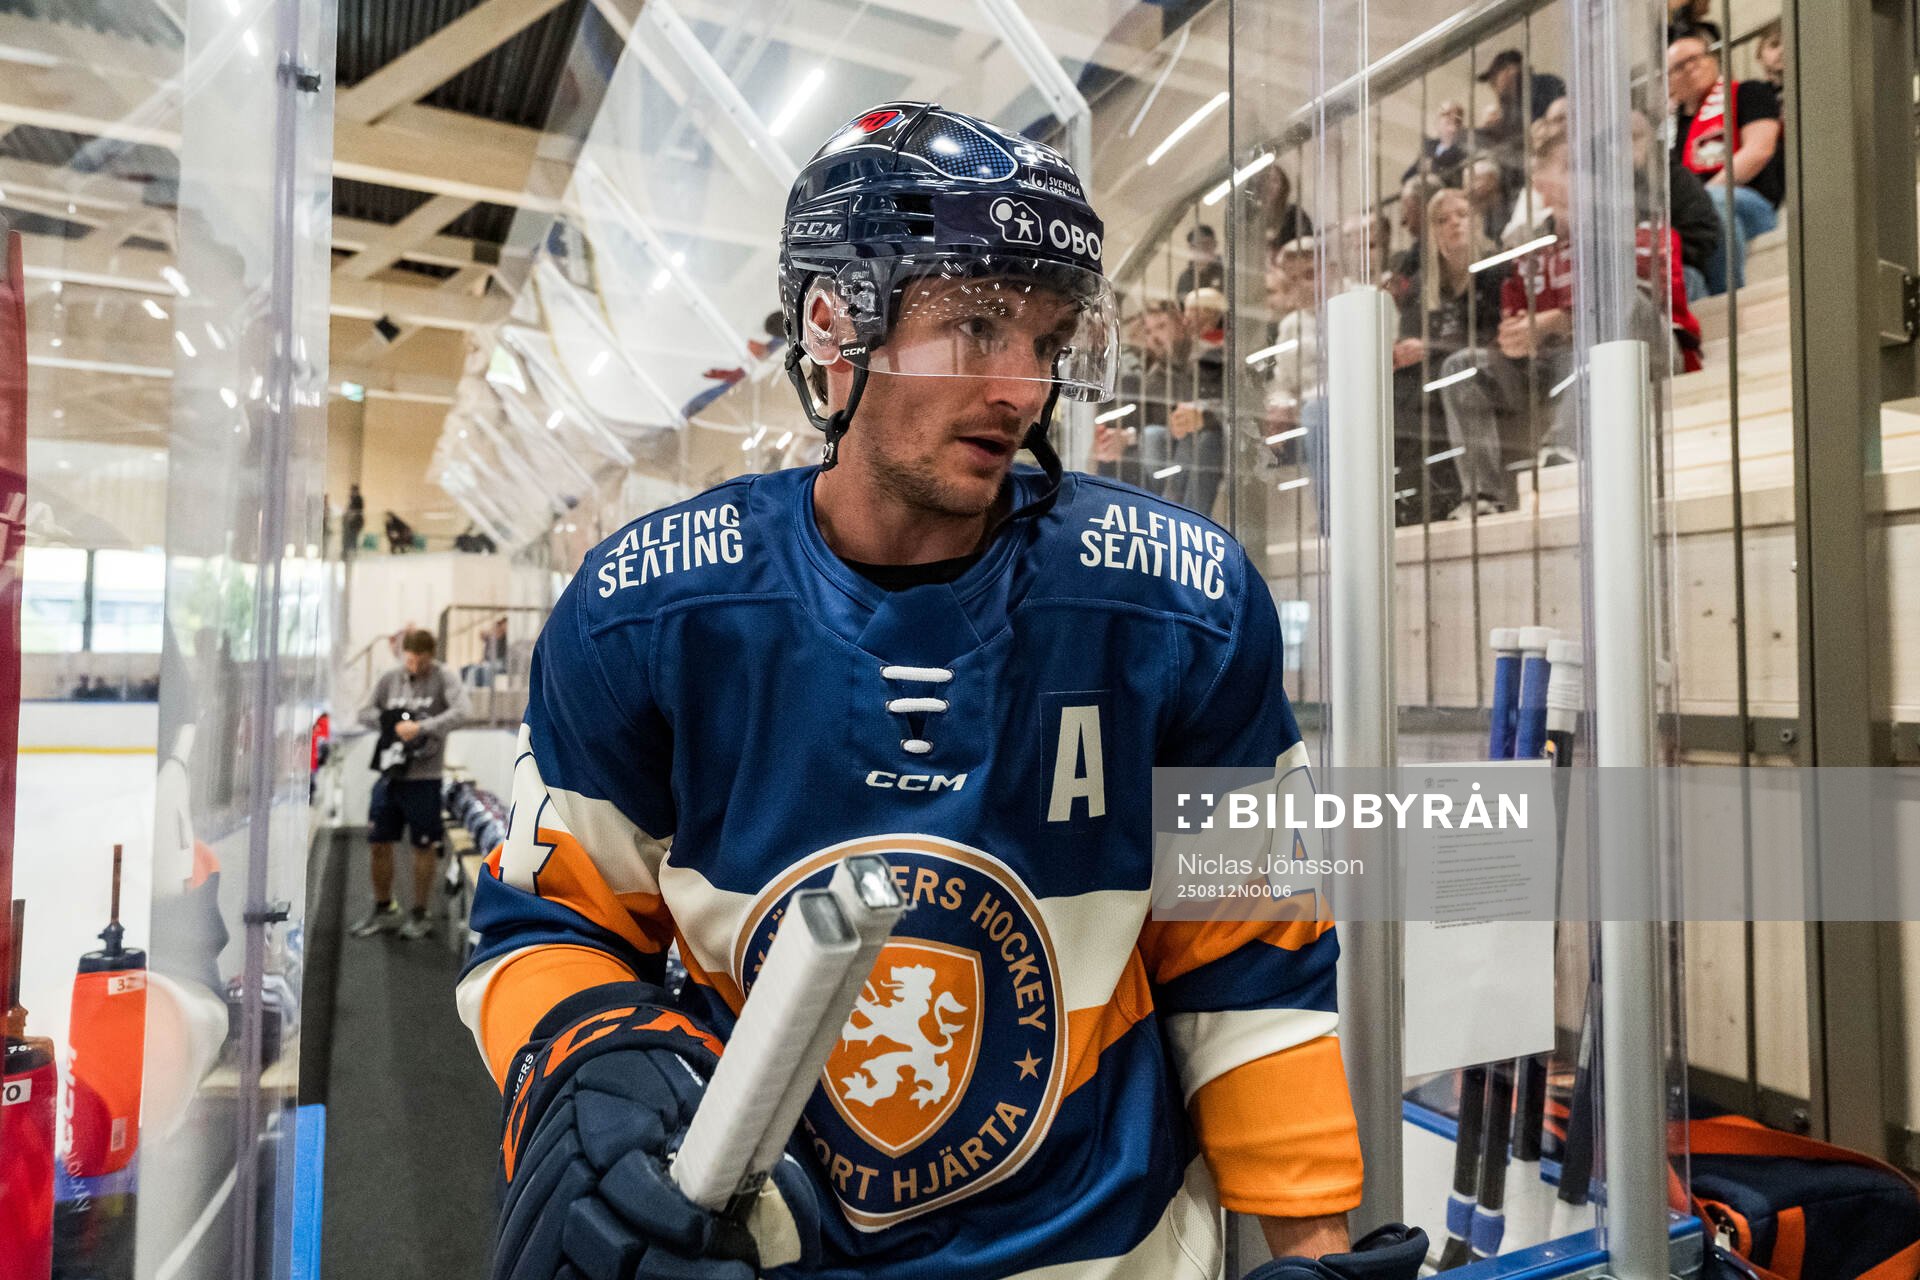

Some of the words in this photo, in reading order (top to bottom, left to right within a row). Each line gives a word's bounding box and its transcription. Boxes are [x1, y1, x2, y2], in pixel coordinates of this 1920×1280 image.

[1048, 176, 1081, 197] SVENSKA
[791, 221, 842, 238] CCM
[842, 346, 867, 358] CCM
[605, 503, 741, 558] ALFING
[1088, 503, 1225, 563] ALFING
[597, 527, 744, 599] SEATING
[1079, 530, 1225, 600] SEATING
[865, 770, 969, 792] CCM
[1047, 704, 1106, 823] A
[889, 865, 967, 911] ERS
[970, 891, 1047, 1032] HOCKEY
[513, 1052, 535, 1100] ERS
[893, 1101, 1028, 1203] HJÄRTA
